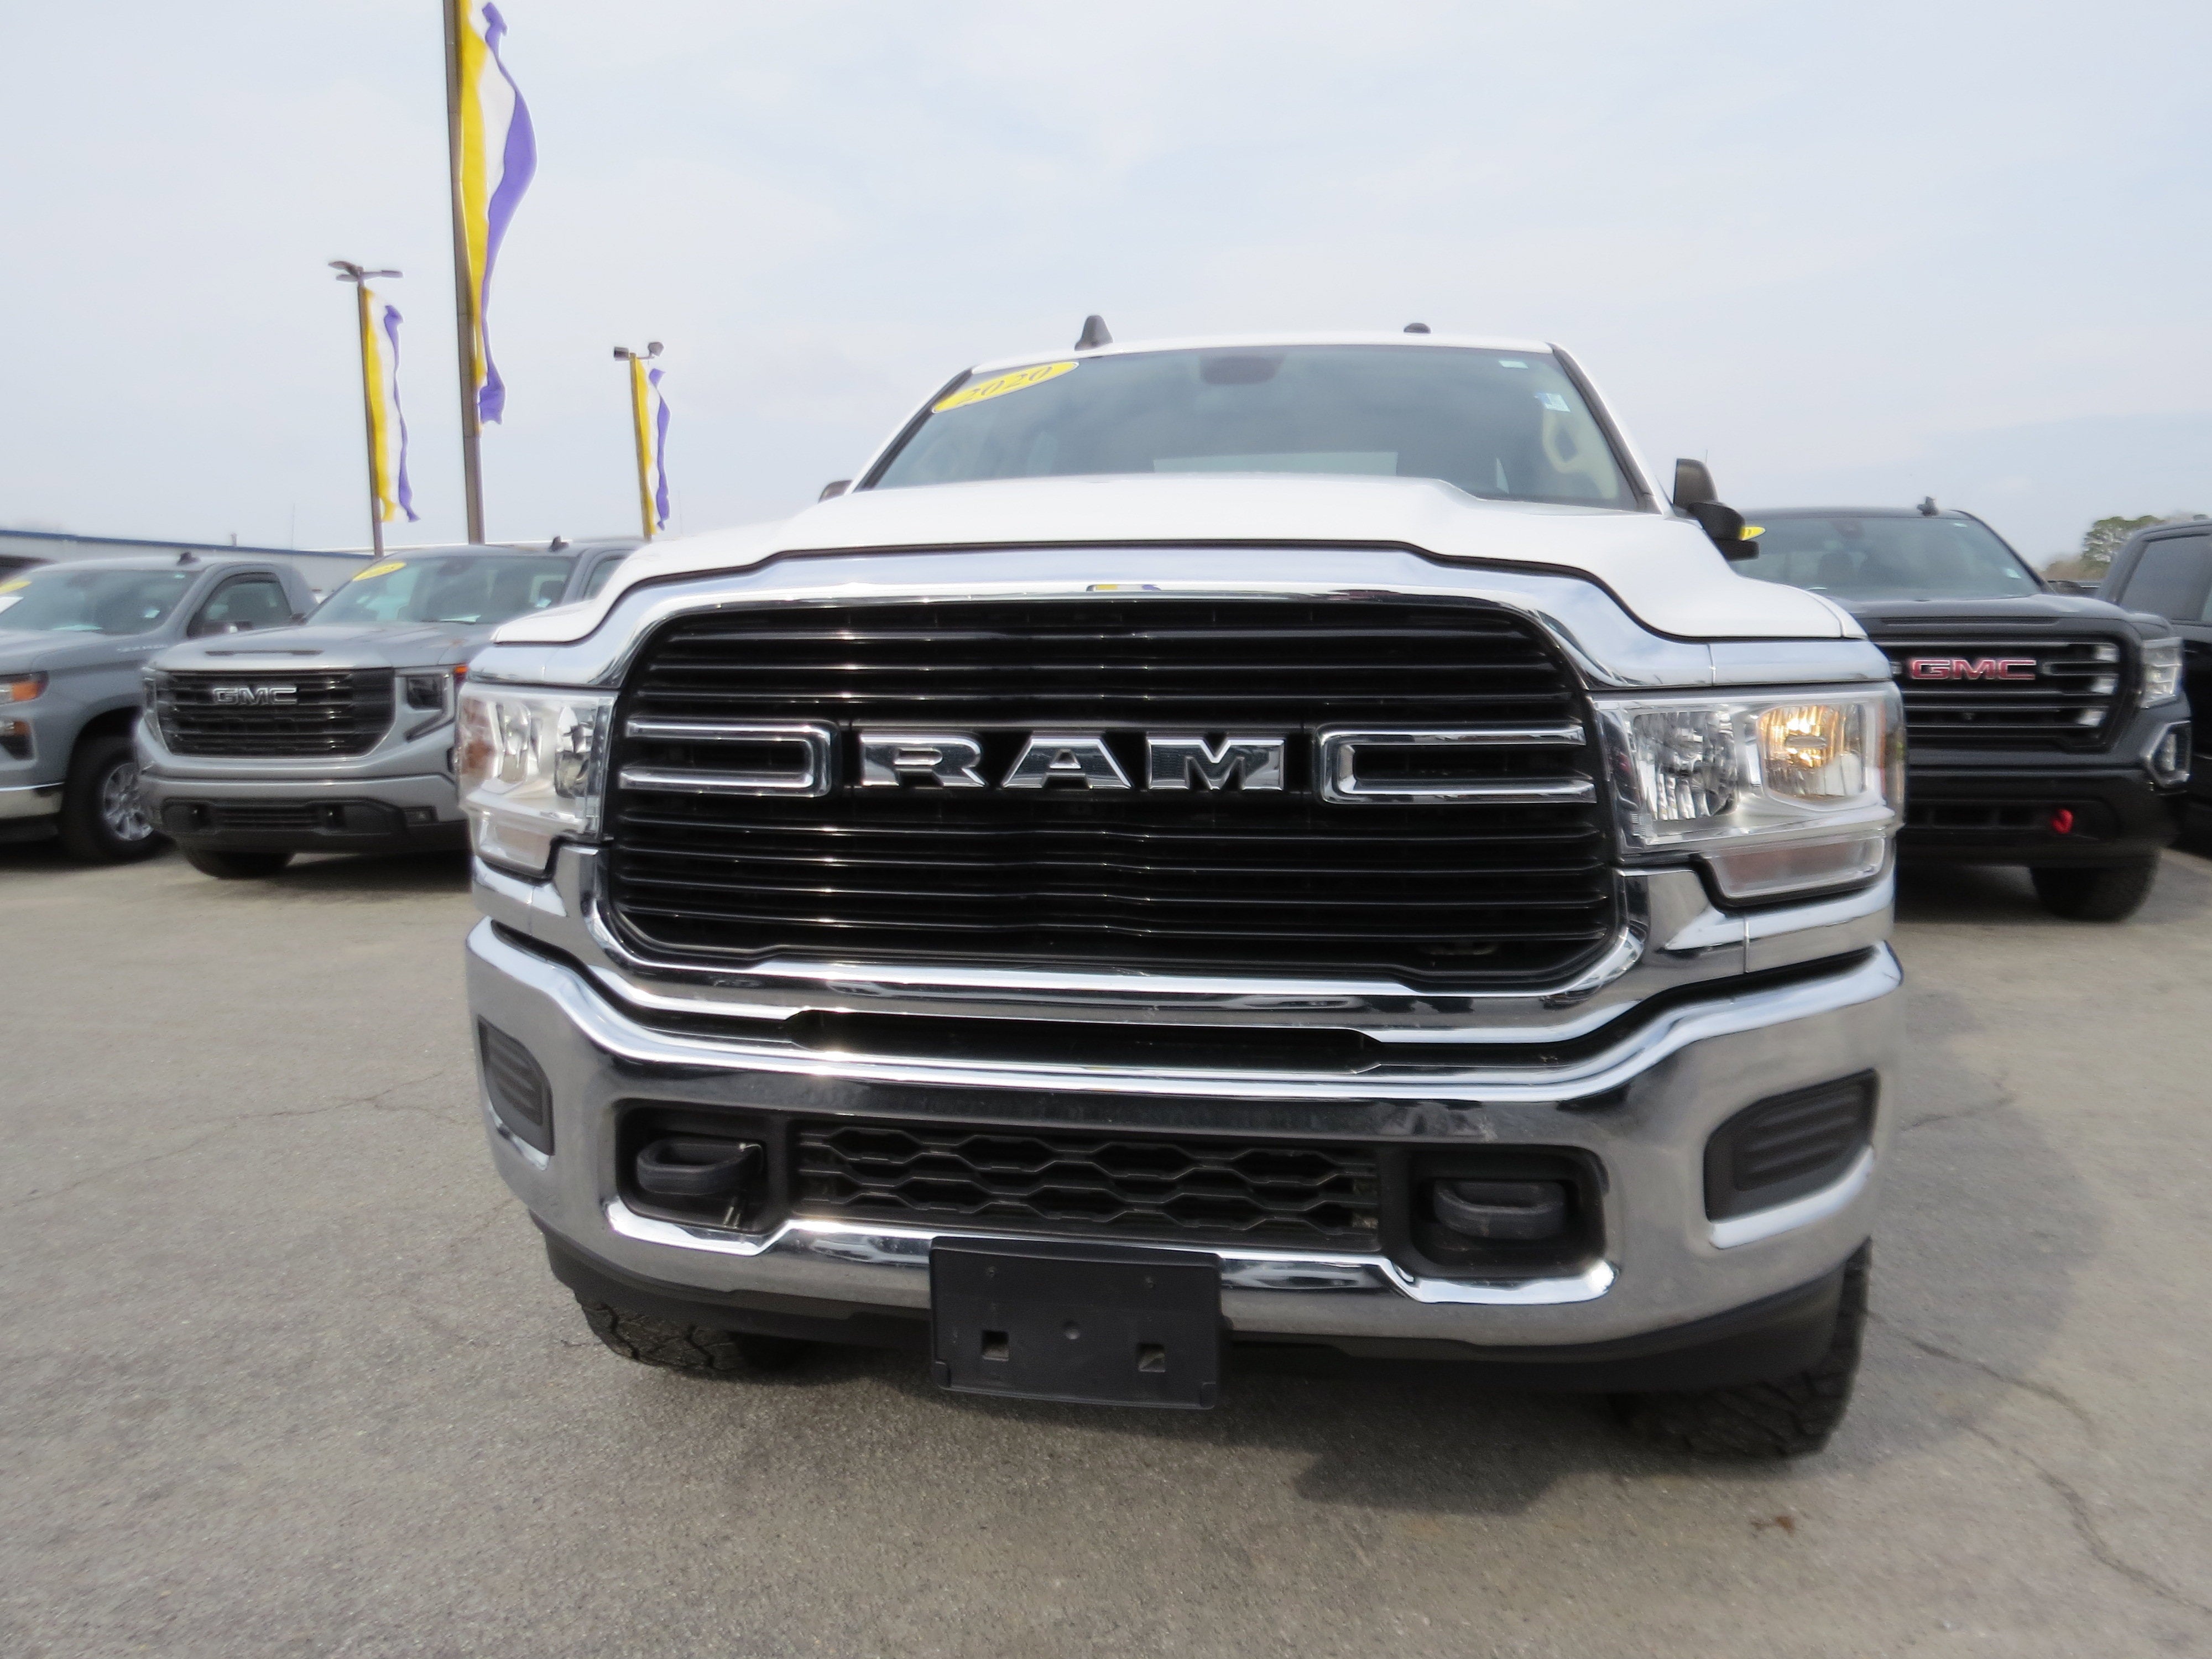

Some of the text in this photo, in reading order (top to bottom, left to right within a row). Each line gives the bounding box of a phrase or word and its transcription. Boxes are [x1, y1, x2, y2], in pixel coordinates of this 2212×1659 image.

[957, 366, 1053, 404] 2020
[1912, 659, 2037, 680] GMC
[212, 687, 298, 705] GMC
[860, 732, 1286, 790] RAM
